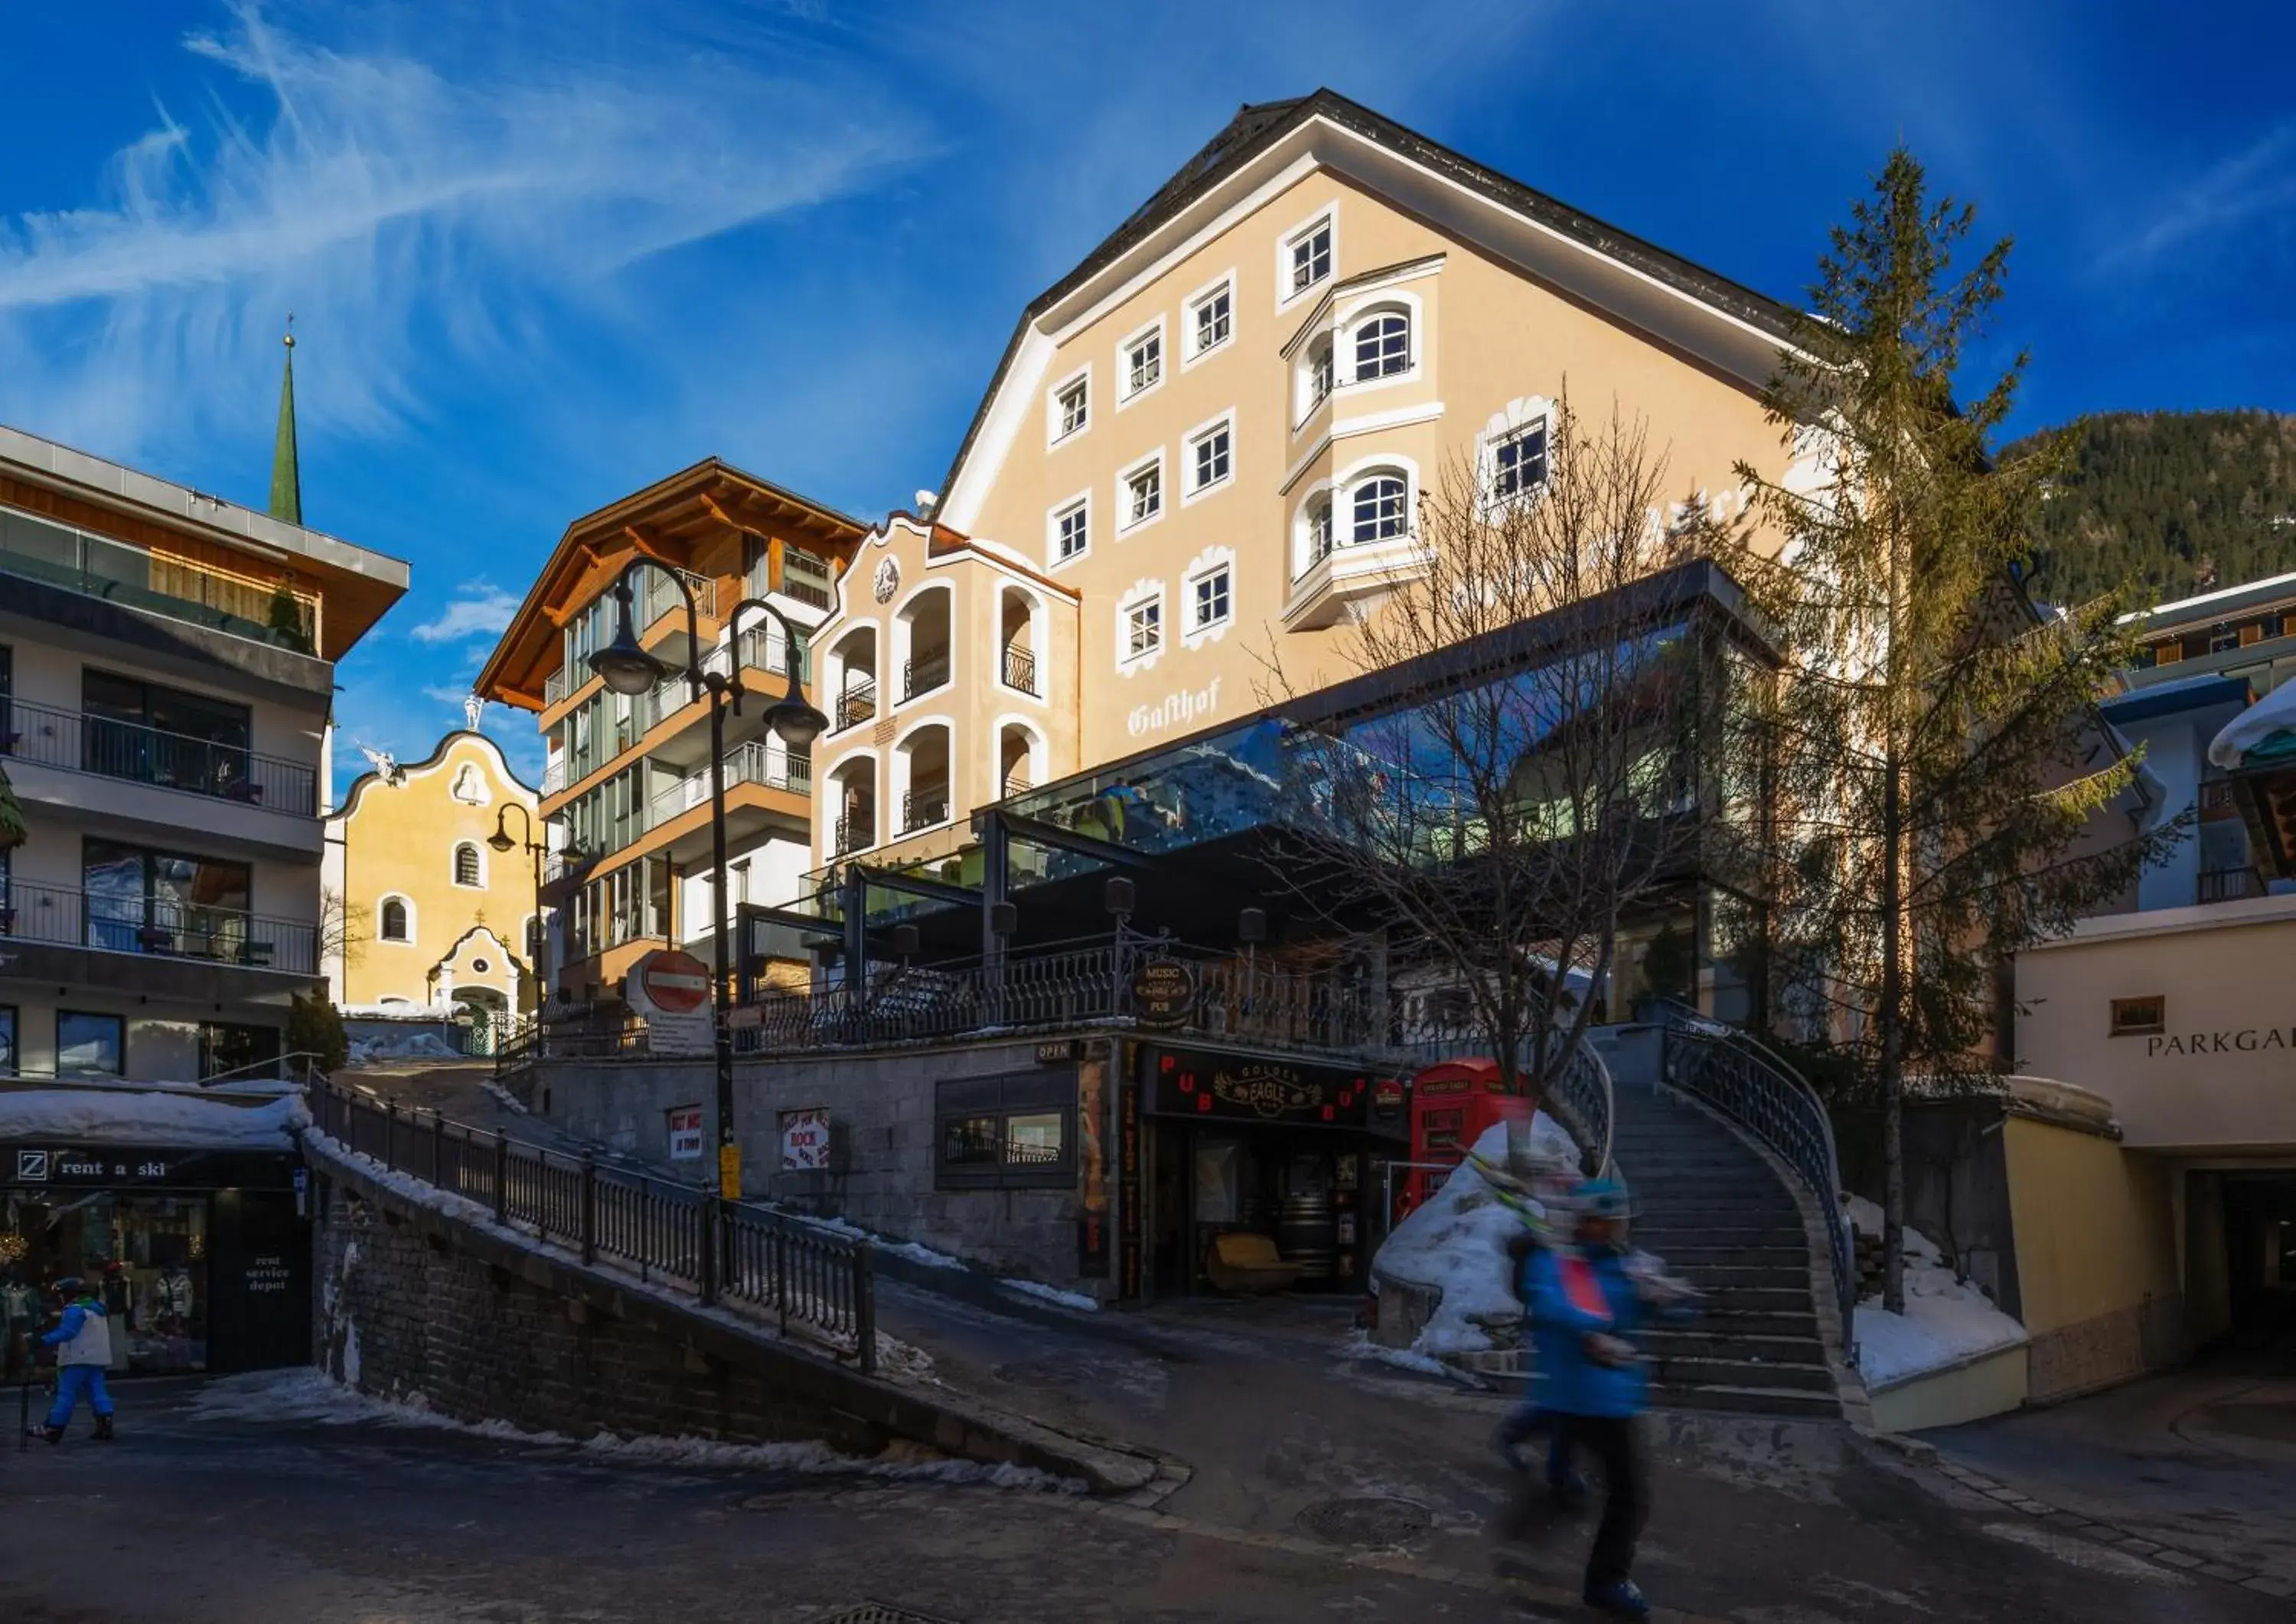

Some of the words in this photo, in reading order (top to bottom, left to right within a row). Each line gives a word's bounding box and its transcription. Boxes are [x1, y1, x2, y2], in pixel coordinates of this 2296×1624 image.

[1146, 967, 1179, 979] MUSIC
[2148, 1027, 2296, 1057] PARKGA
[1039, 1045, 1068, 1058] OPEN
[1241, 1065, 1300, 1082] GOLDEN
[1250, 1081, 1286, 1104] EAGLE
[21, 1153, 46, 1178] Z
[61, 1161, 103, 1176] rent
[115, 1164, 126, 1176] a
[138, 1161, 165, 1176] ski
